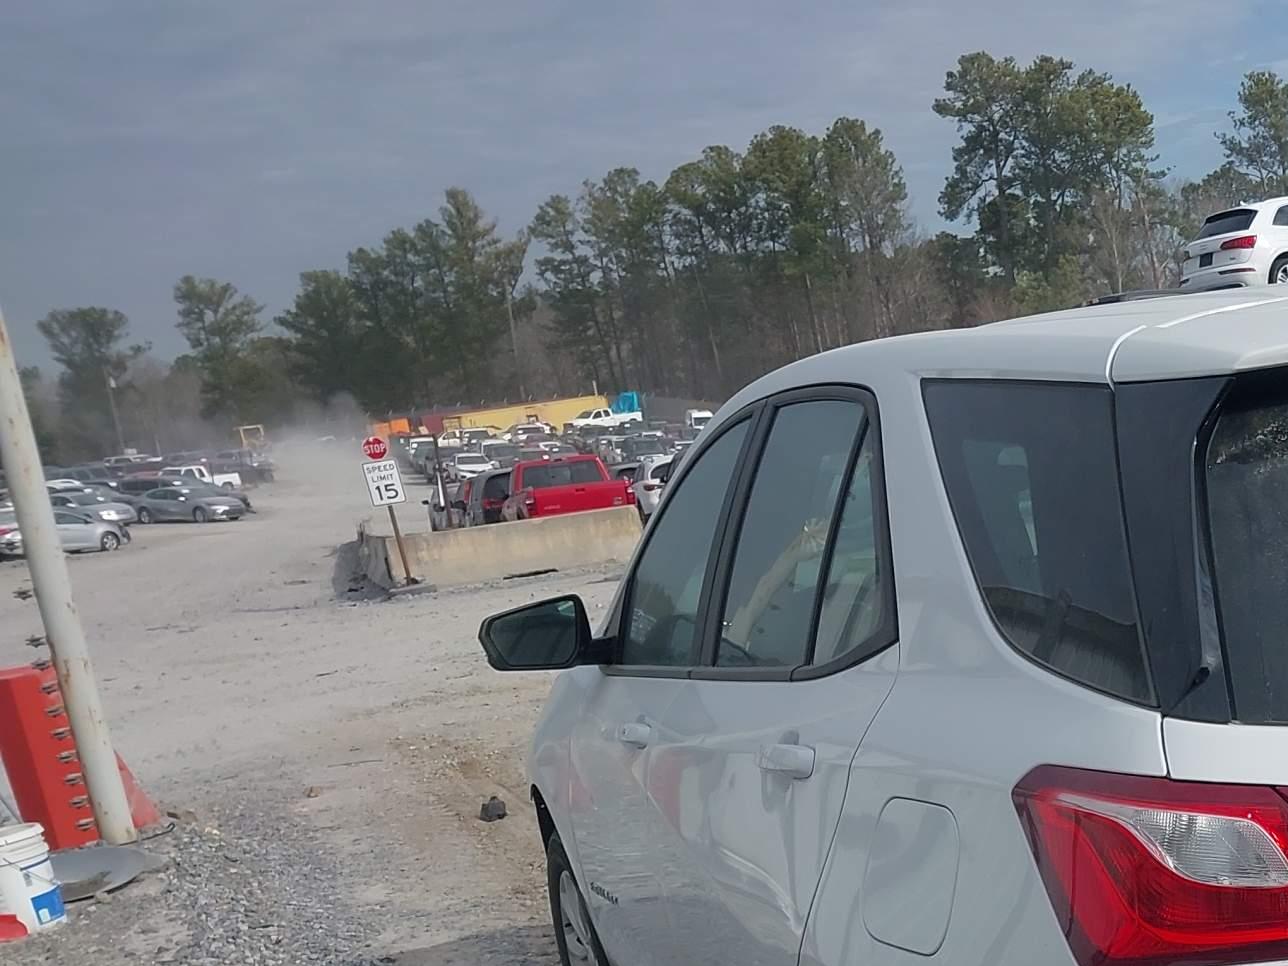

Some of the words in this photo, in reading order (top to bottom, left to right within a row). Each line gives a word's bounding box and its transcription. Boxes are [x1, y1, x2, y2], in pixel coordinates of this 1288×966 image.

[364, 443, 386, 454] STOP
[366, 463, 395, 474] SPEED
[371, 473, 394, 483] LIMIT
[375, 483, 399, 501] 15
